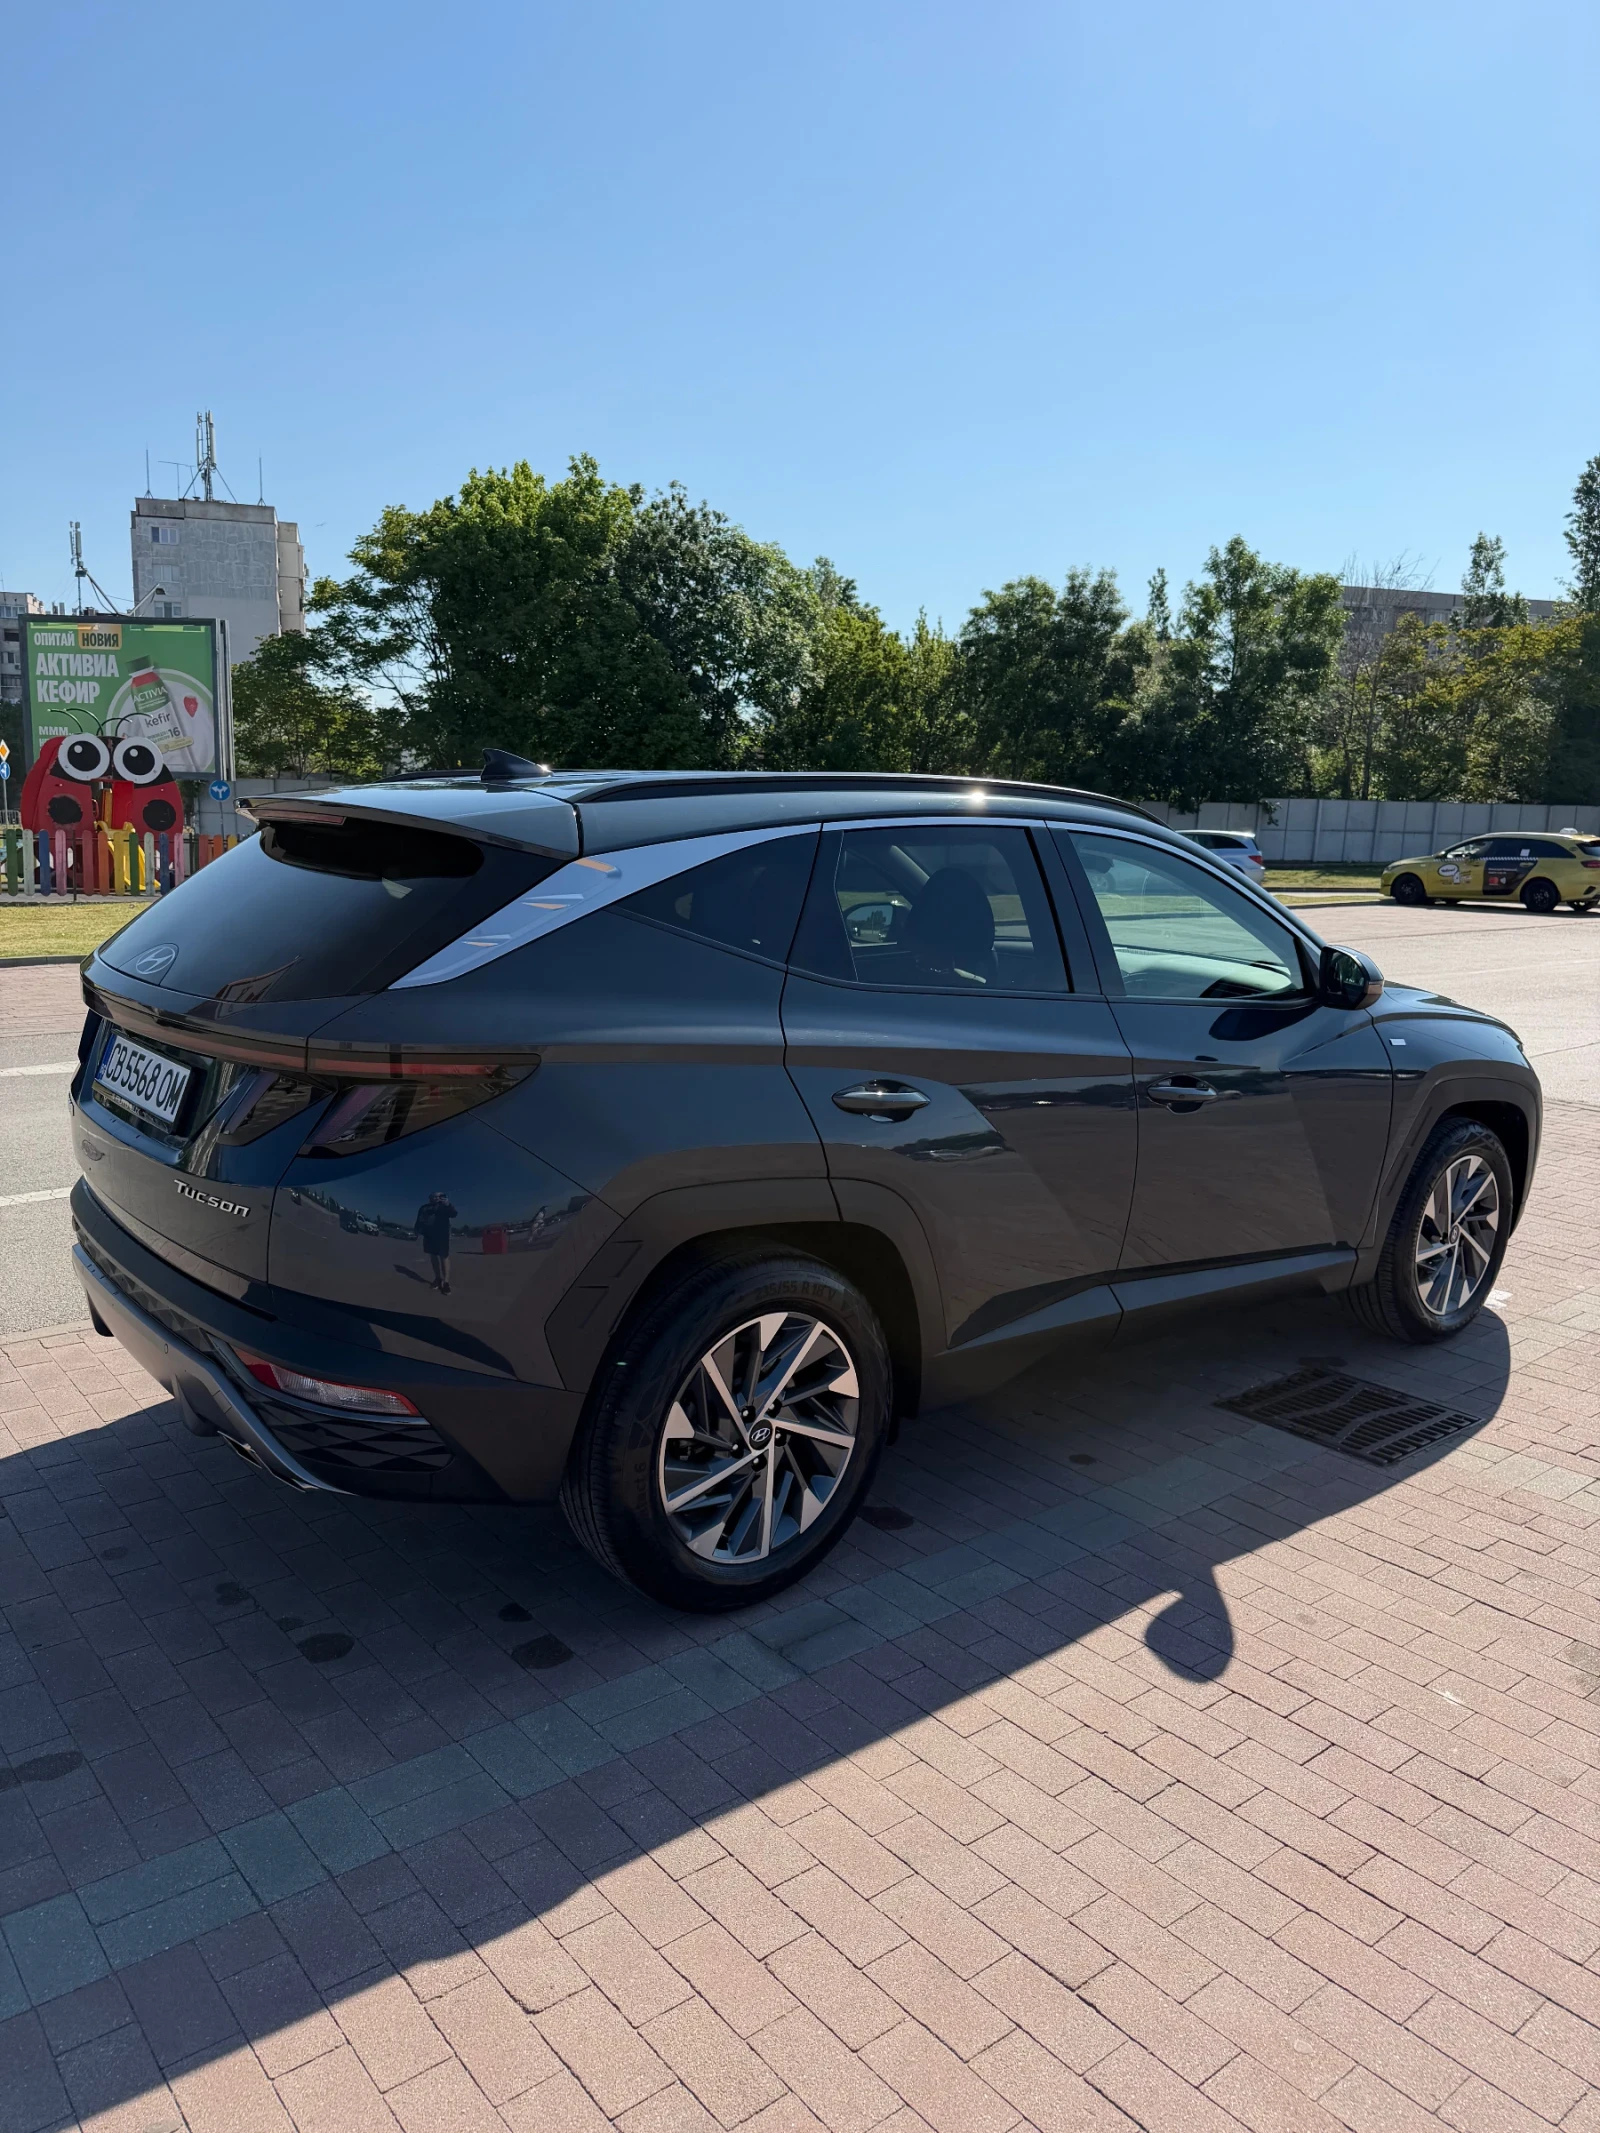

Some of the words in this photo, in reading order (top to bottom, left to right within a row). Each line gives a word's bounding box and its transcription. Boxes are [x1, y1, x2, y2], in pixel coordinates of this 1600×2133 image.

[34, 631, 75, 647] ОПИТАЙ
[82, 633, 119, 647] НОВИЯ
[36, 652, 119, 677] АКТИВИА
[37, 680, 100, 704] КЕФИР
[133, 686, 168, 702] ACTIVIA
[144, 712, 171, 728] kefir
[168, 726, 181, 738] 16
[174, 1179, 249, 1218] Tucson
[755, 1280, 797, 1302] 235/55
